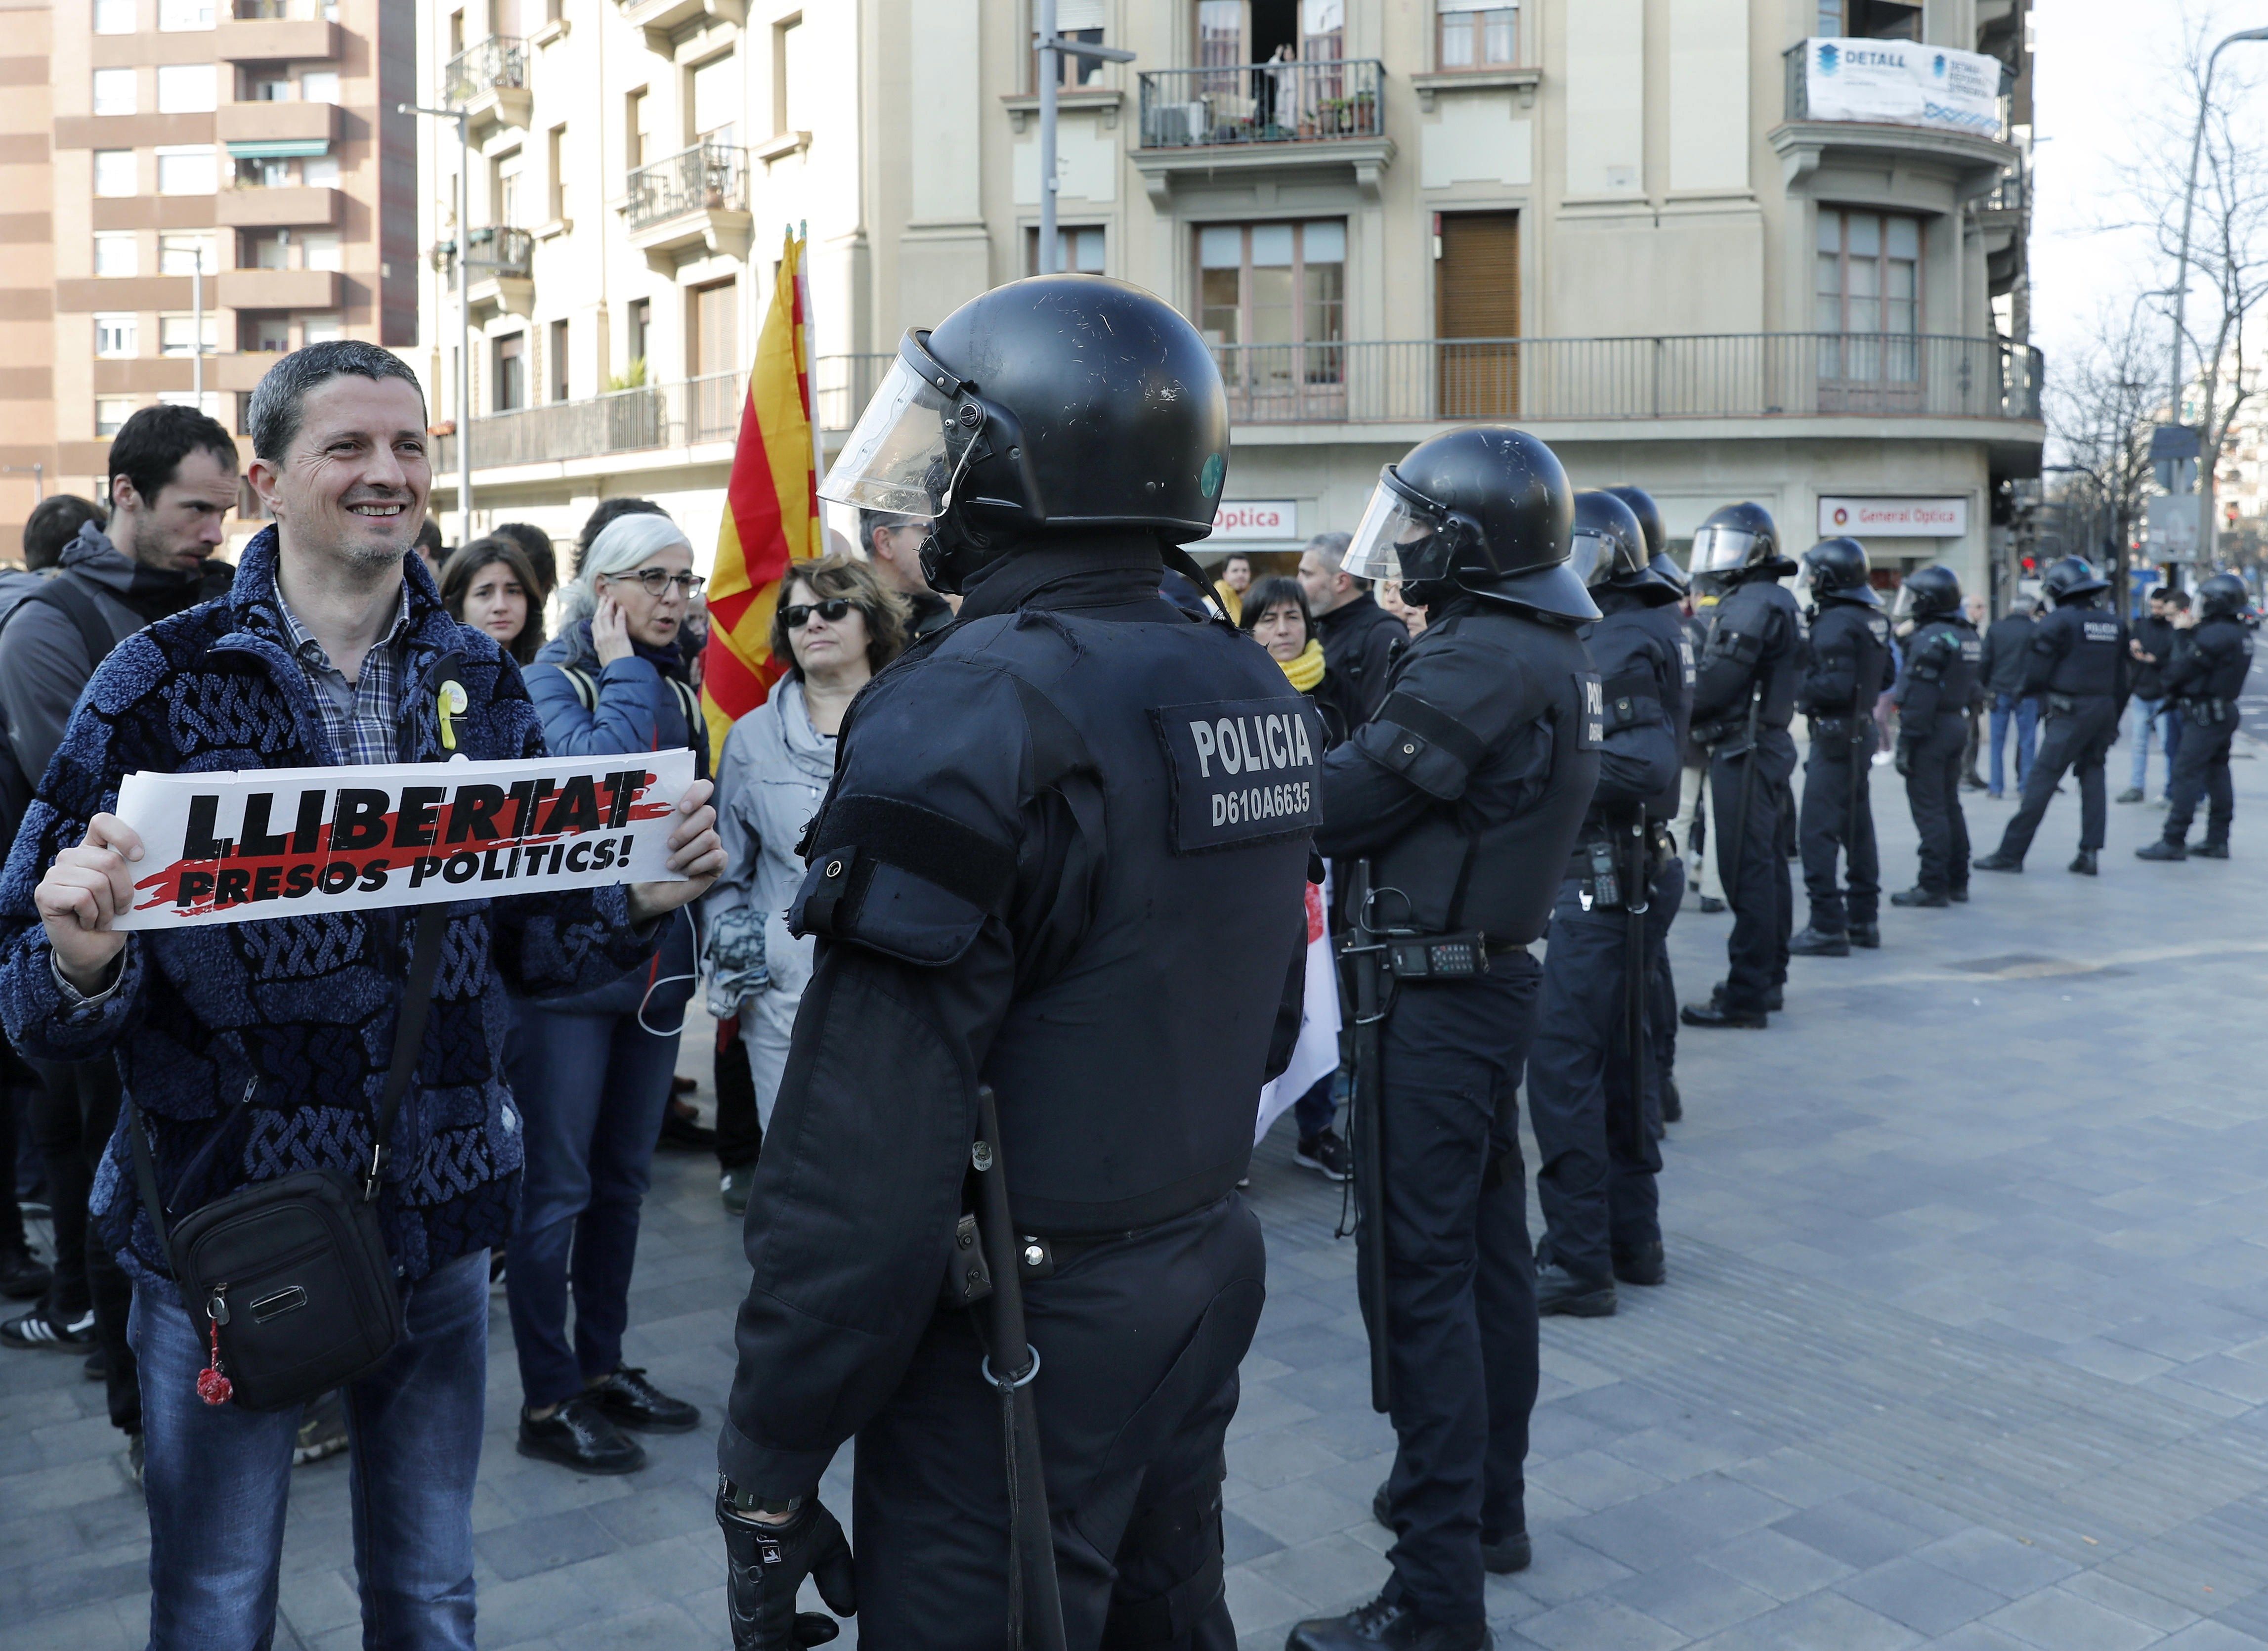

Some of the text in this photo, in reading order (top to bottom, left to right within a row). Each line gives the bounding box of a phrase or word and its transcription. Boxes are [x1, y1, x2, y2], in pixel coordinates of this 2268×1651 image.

[1845, 50, 1906, 68] DETALL
[1213, 508, 1280, 531] Optica
[1859, 507, 1955, 526] General Optica
[1189, 714, 1313, 778] POLICIA
[182, 769, 647, 861] LLIBERTAT
[1212, 782, 1310, 827] D610A6635
[176, 834, 632, 908] PRESOS POLITICS!
